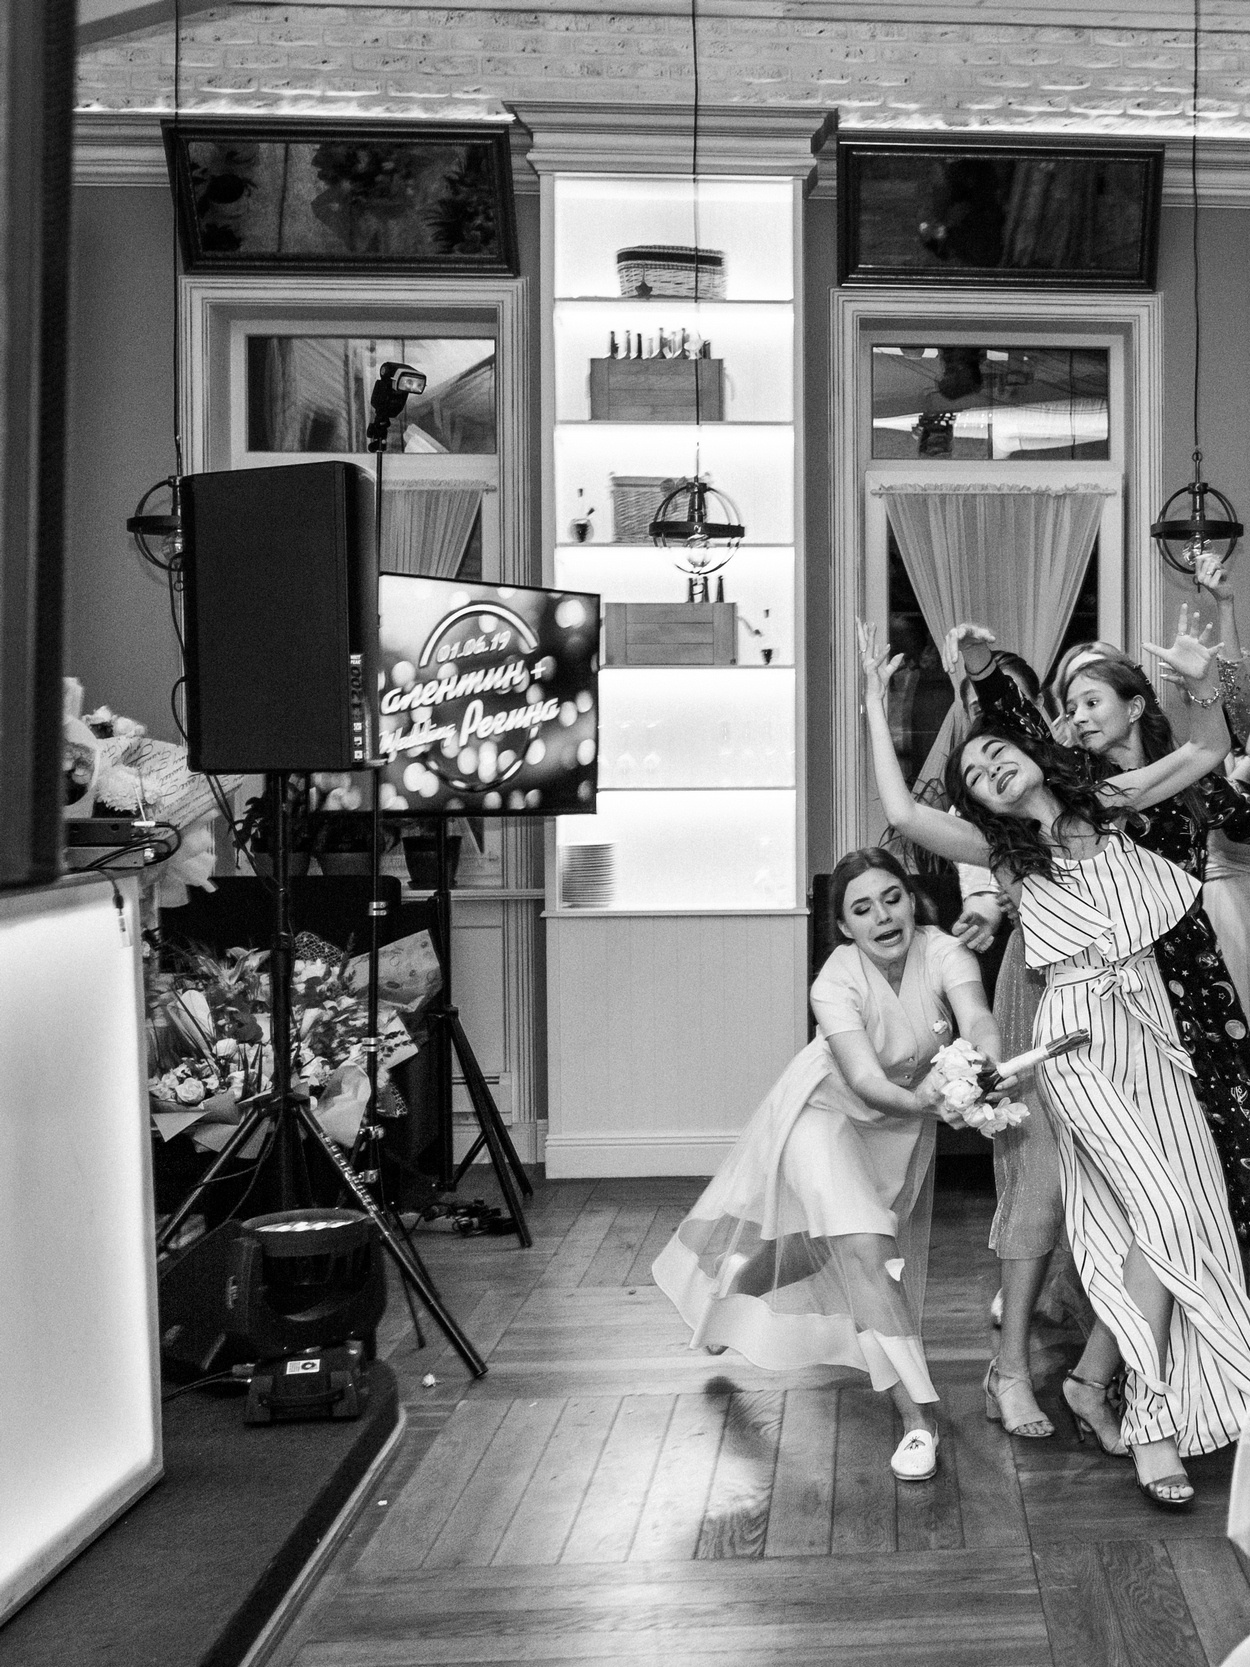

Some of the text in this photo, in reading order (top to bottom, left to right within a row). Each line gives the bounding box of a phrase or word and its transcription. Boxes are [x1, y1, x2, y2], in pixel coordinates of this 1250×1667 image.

[437, 630, 512, 663] 01.06.19
[381, 660, 526, 715] алентин
[459, 698, 561, 748] Регина
